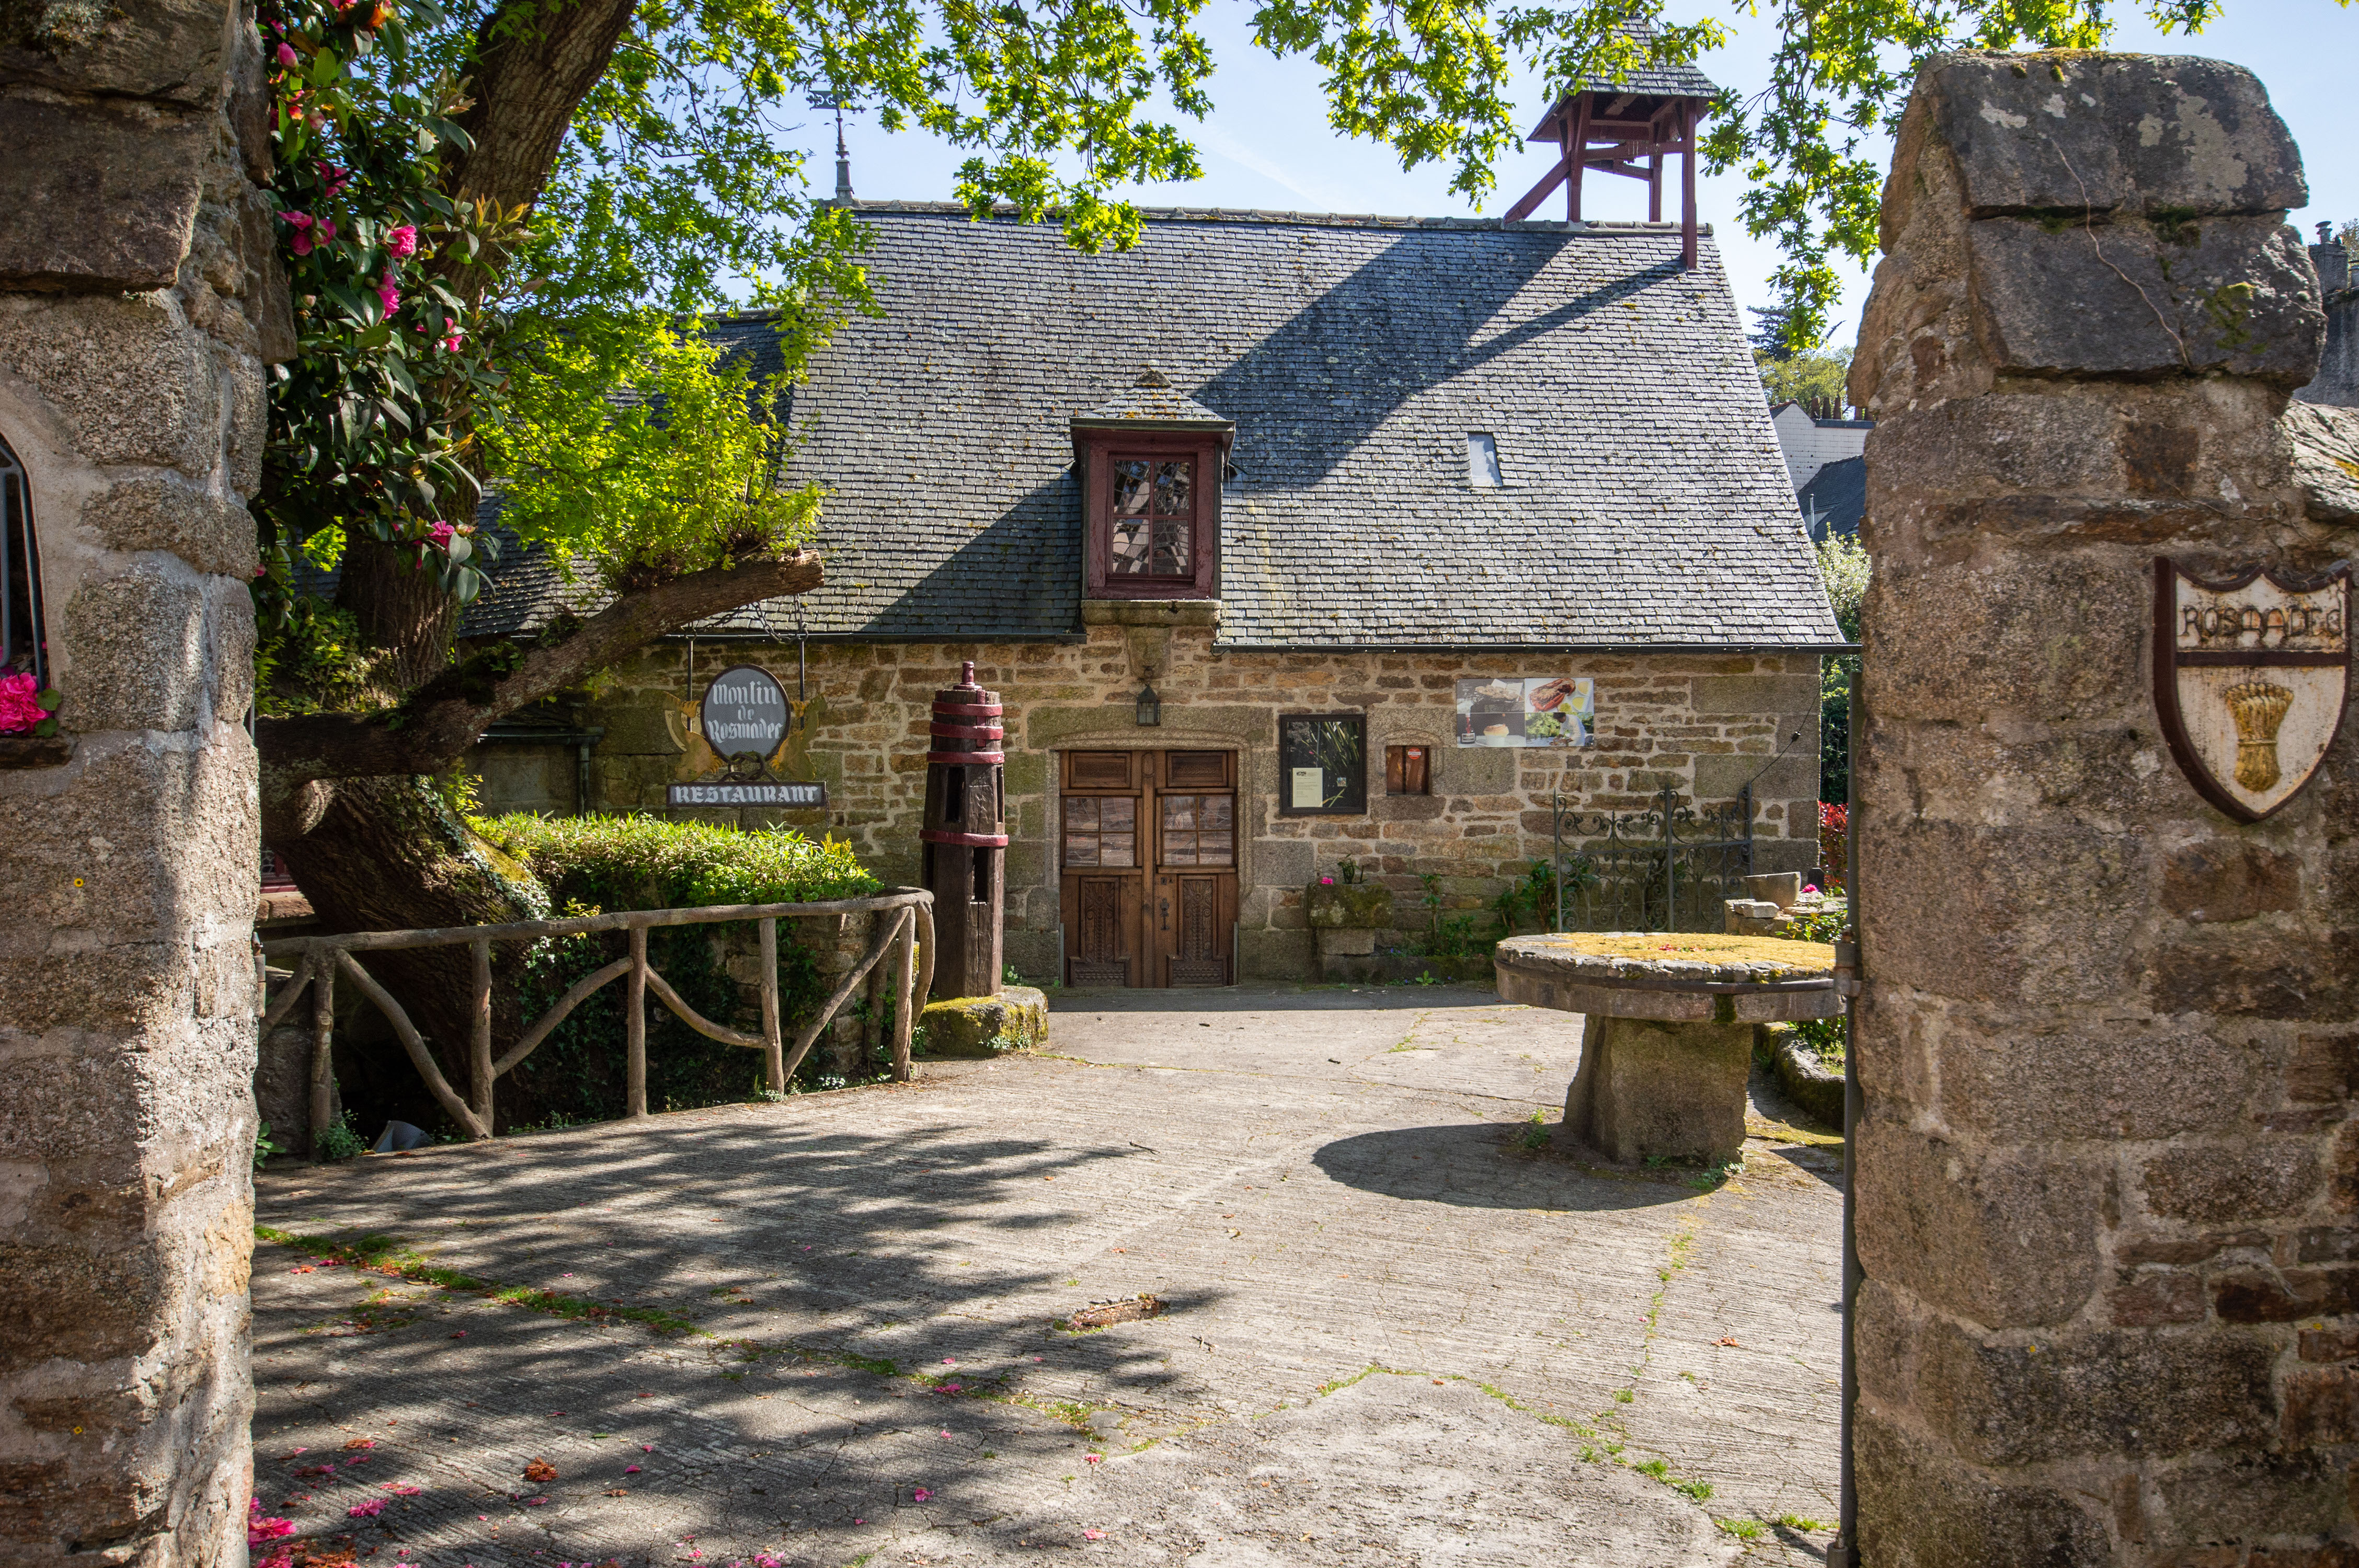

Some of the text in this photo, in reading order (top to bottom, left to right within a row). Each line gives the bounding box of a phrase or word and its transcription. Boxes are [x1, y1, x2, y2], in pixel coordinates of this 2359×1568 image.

[713, 681, 779, 705] Moulin
[738, 705, 754, 721] de
[675, 786, 819, 803] RESTAURANT
